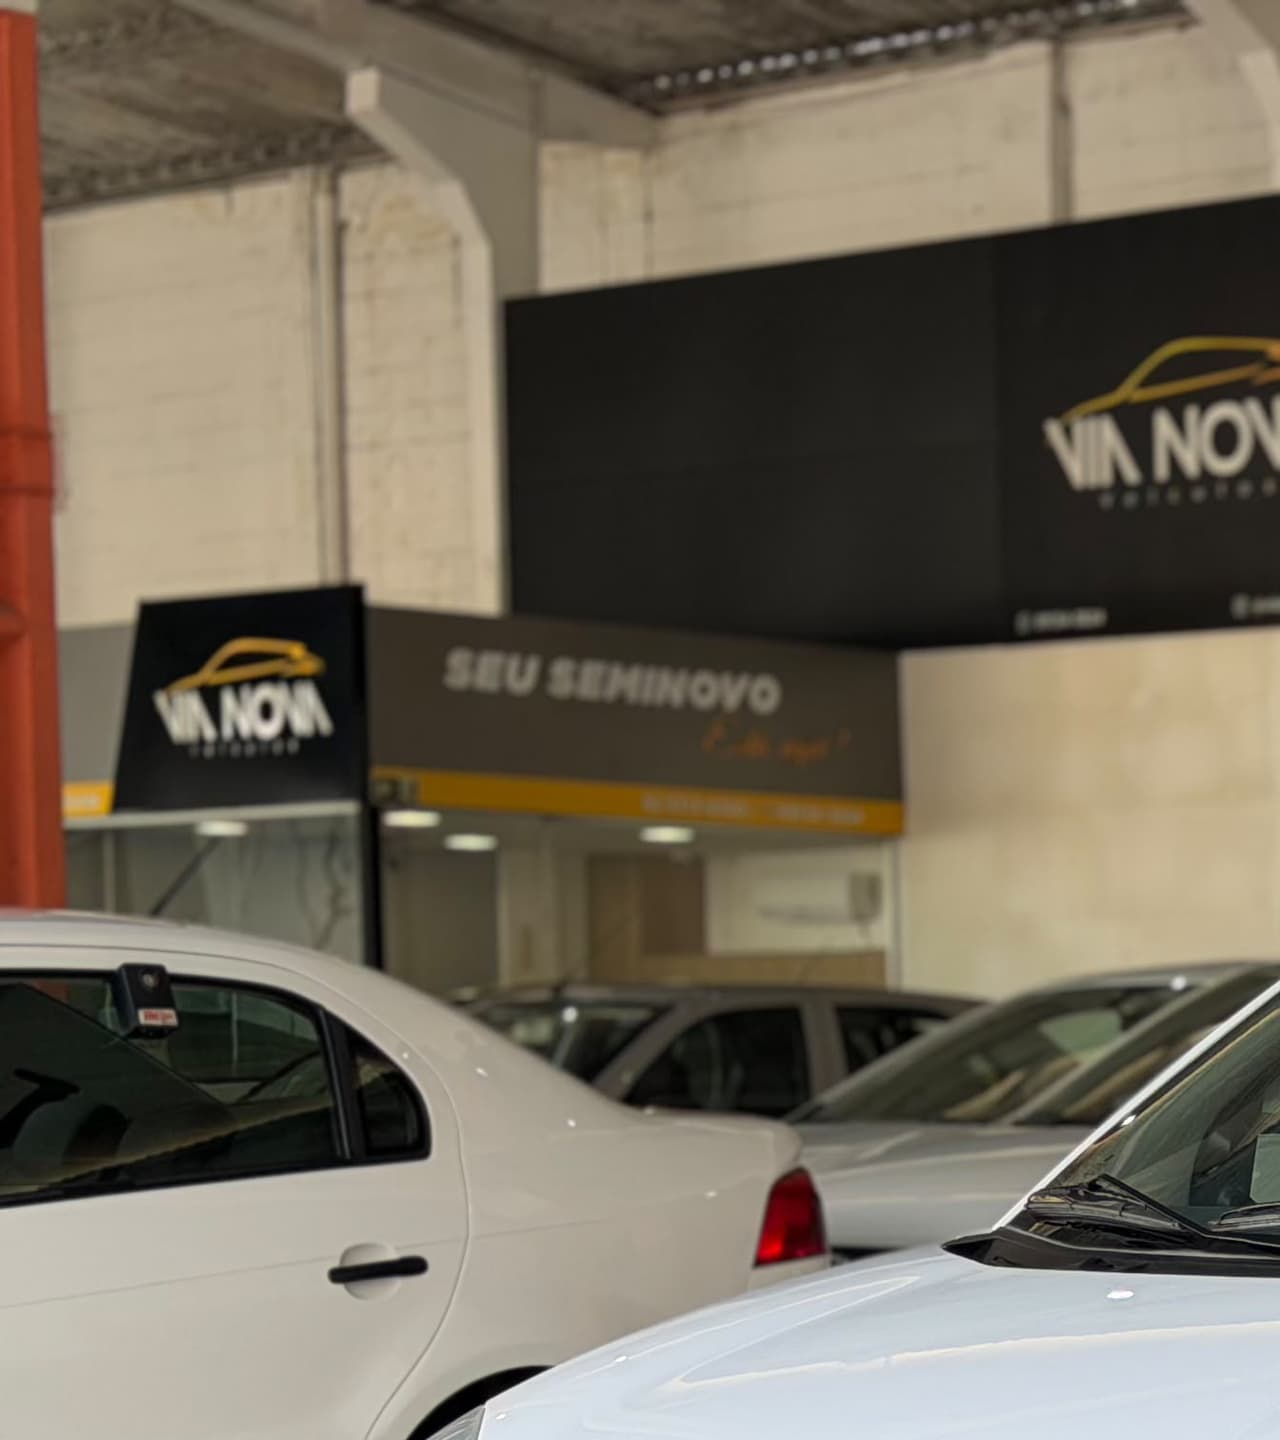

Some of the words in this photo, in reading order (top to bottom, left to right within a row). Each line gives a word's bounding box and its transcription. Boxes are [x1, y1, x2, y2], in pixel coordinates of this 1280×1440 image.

[1043, 412, 1142, 492] VIA
[153, 689, 217, 745] VIA
[219, 678, 335, 742] NOVA
[443, 647, 541, 696] SEU
[545, 656, 783, 716] SEMINOVO
